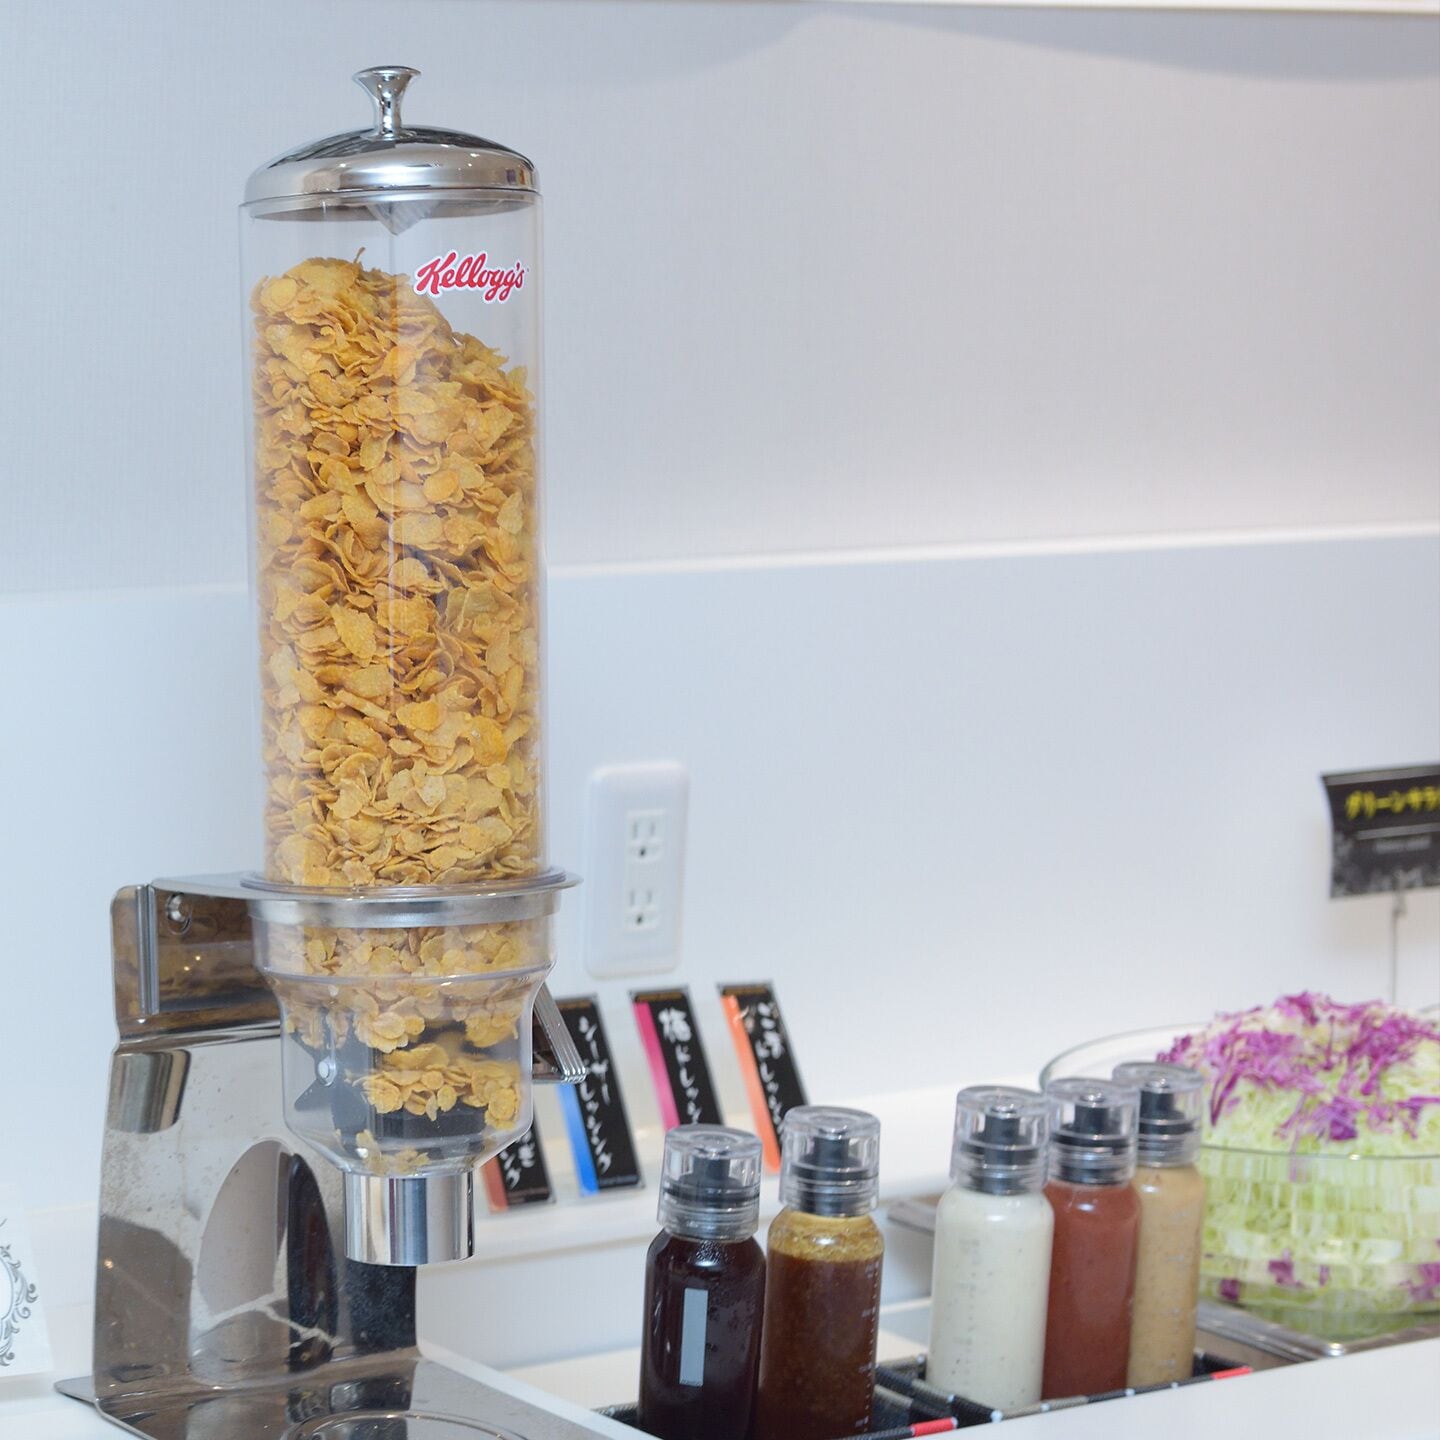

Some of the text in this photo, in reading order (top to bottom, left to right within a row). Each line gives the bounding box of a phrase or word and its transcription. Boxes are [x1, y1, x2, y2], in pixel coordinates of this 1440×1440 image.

[416, 251, 525, 301] Kellogg's
[579, 1077, 612, 1174] レッシング
